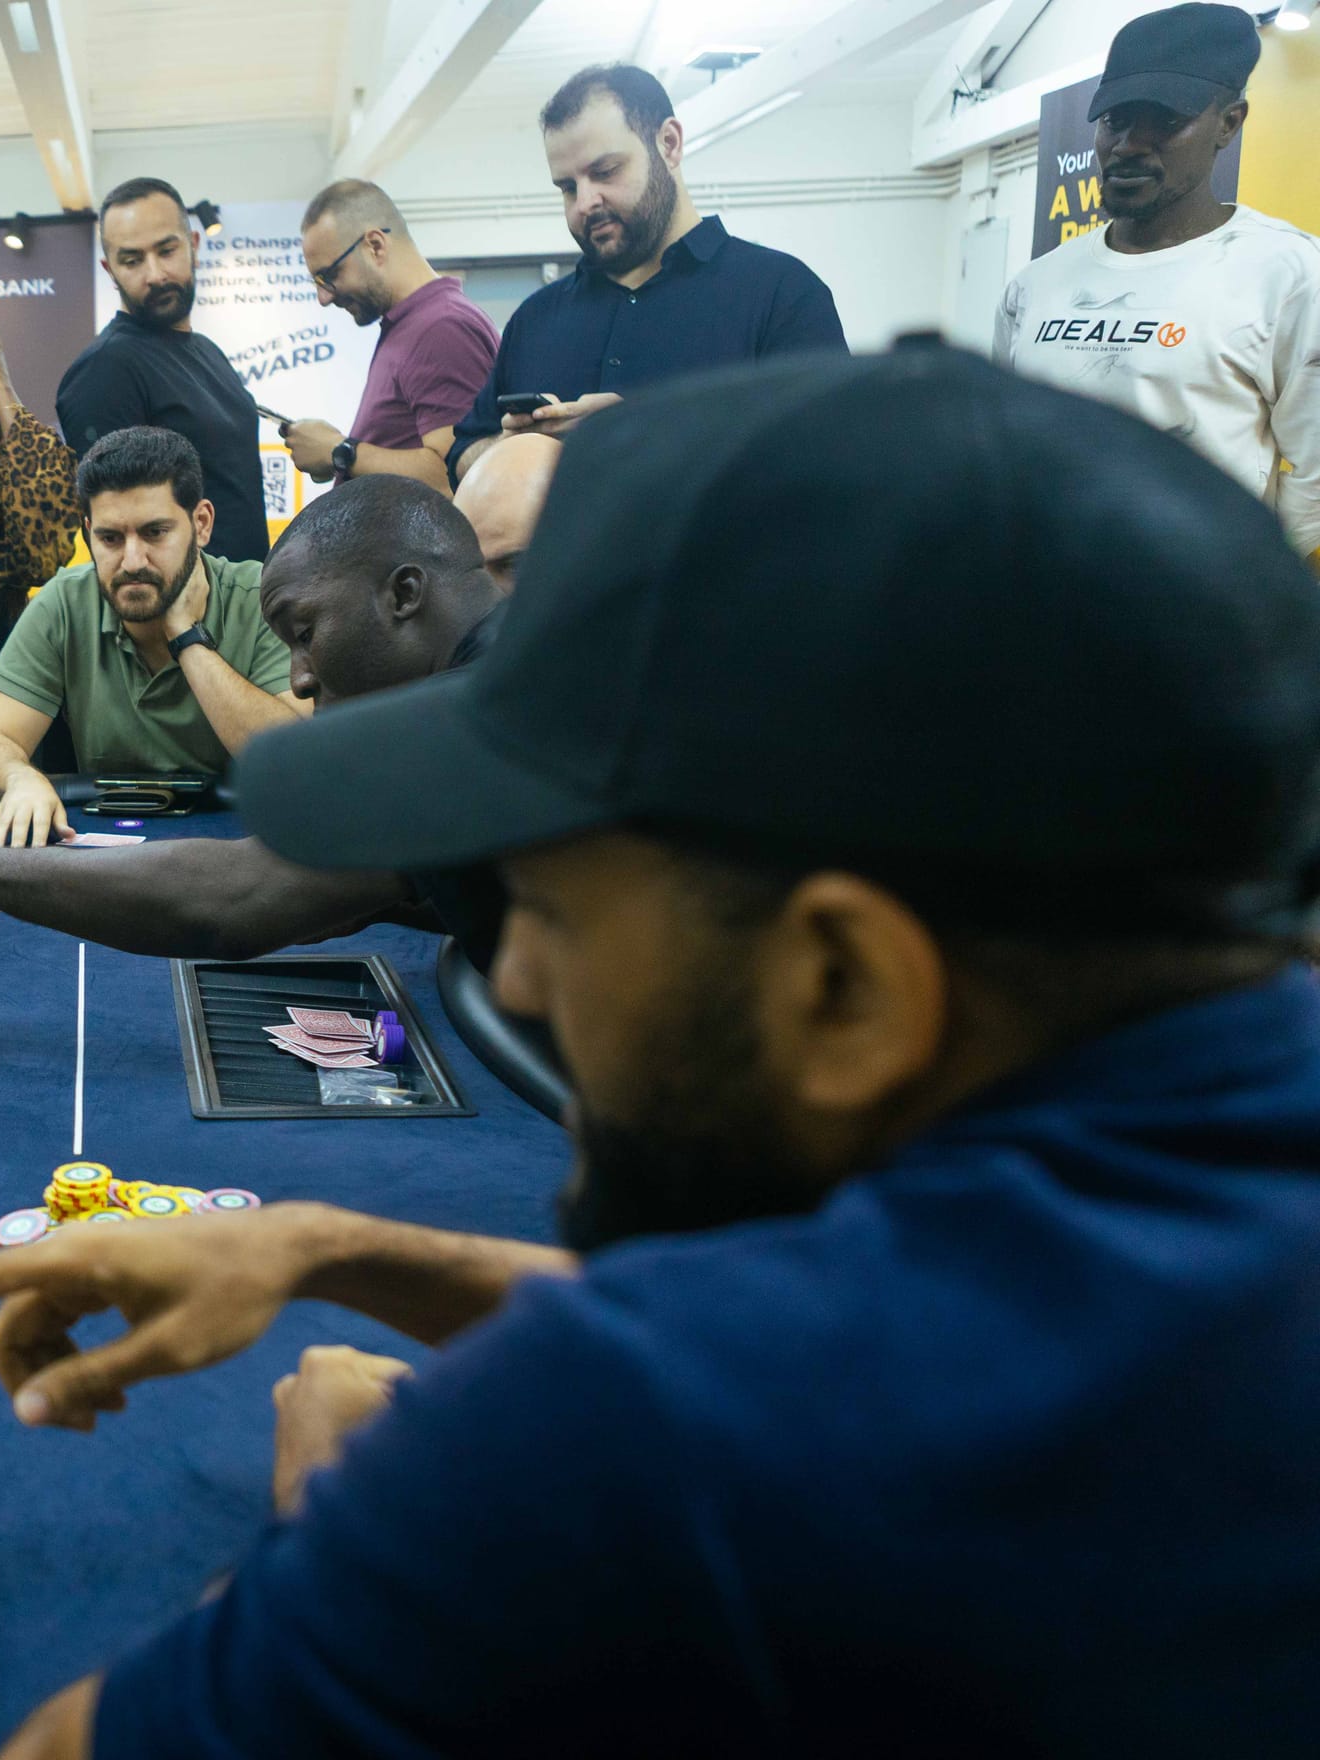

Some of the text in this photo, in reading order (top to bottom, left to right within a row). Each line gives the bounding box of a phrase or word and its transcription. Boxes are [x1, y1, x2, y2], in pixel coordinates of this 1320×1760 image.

[1057, 149, 1095, 176] Your
[1049, 185, 1070, 221] A
[206, 240, 225, 251] to
[234, 254, 291, 268] Select
[234, 292, 273, 304] New
[288, 325, 328, 343] YOU
